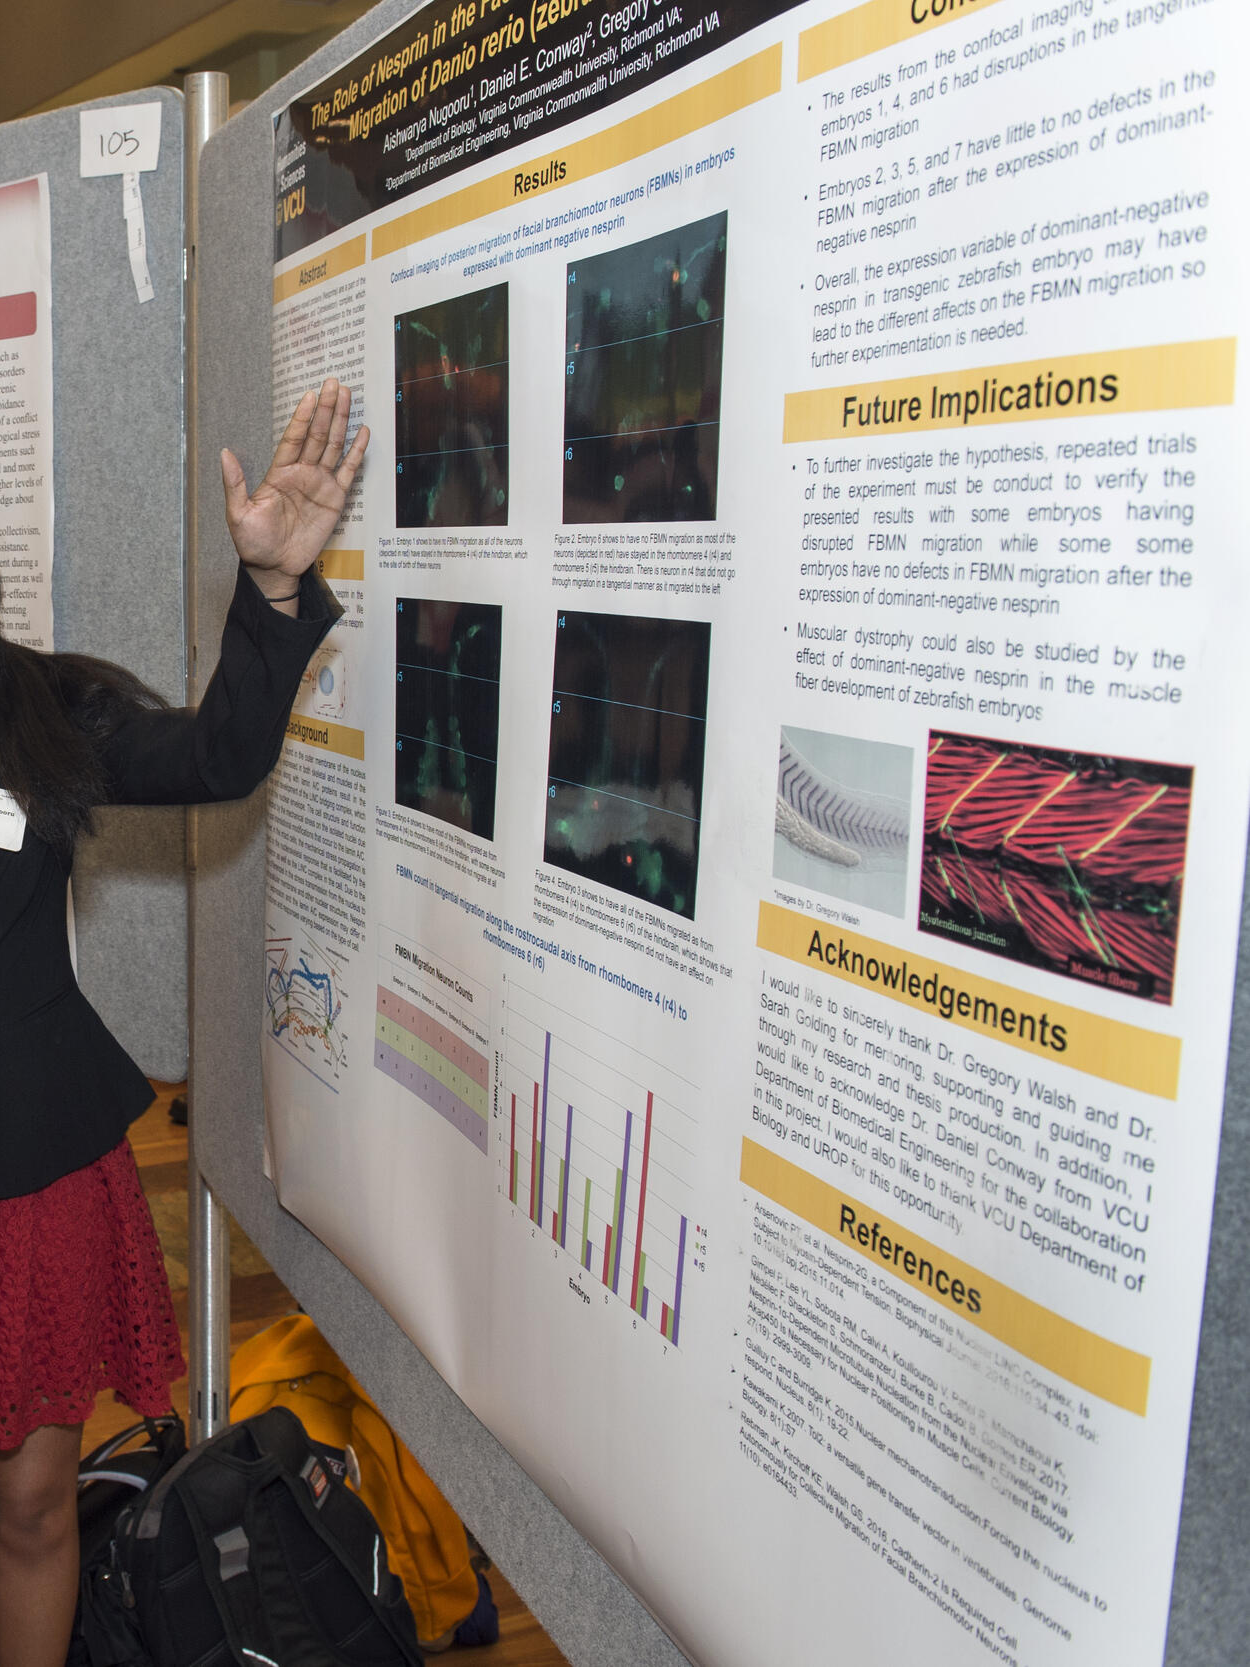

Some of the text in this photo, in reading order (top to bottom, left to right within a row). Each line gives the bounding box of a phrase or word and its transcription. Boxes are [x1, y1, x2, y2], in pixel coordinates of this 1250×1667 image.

[311, 102, 329, 130] The
[333, 80, 358, 116] Role
[361, 70, 376, 93] of
[376, 32, 428, 82] Nesprin
[433, 20, 445, 50] in
[451, 3, 475, 38] the
[350, 86, 407, 141] Migration
[411, 75, 426, 103] of
[430, 42, 475, 93] Danio
[480, 14, 525, 63] rerio
[383, 117, 426, 154] Aishwarya
[480, 65, 515, 102] Daniel
[520, 57, 532, 81] E.
[600, 0, 650, 39] Gregory
[422, 161, 428, 174] of
[429, 141, 464, 171] Biomedical
[466, 121, 511, 154] Engineering,
[514, 106, 543, 131] Virginia
[610, 53, 653, 86] University,
[656, 19, 702, 62] Richmond
[705, 11, 719, 33] VA
[443, 127, 450, 142] of
[451, 118, 477, 139] Biology,
[479, 100, 506, 124] Virginia
[509, 70, 572, 111] Commonwealth
[576, 46, 618, 79] University,
[621, 18, 664, 56] Richmond
[666, 8, 682, 27] VA;
[100, 130, 140, 157] 105
[819, 68, 1216, 203] Embryos 2, 3, 5, and 7 have little to no defects in the
[283, 186, 306, 223] VCU
[514, 159, 566, 197] Results
[391, 146, 735, 284] Confocal imaging of posterior migration of facial branchiomotor neurons (FBMNs) in embryos
[463, 214, 625, 278] expressed with dominant negative nesprin
[299, 259, 327, 286] Abstract
[568, 271, 576, 286] r4
[12, 352, 19, 360] as
[566, 361, 575, 375] r5
[842, 372, 1119, 428] Future Implications
[565, 446, 573, 461] r6
[807, 433, 1196, 476] To further investigate the hypothesis, repeated trials
[396, 864, 687, 1022] FBMN count in tangential migration along the rostrocaudal axis from rhombomere 4 (r4) to
[807, 929, 1069, 1053] Acknowledgements
[770, 976, 799, 999] would
[827, 996, 838, 1014] to
[843, 1006, 894, 1041] sincerely
[899, 1026, 931, 1055] thank
[937, 1043, 956, 1066] Dr.
[963, 1054, 1021, 1095] Gregory
[1028, 1078, 1076, 1114] Walsh
[1086, 1104, 1118, 1131] and
[1128, 1116, 1156, 1144] Dr.
[568, 1276, 591, 1305] Embryo
[839, 1203, 982, 1316] References
